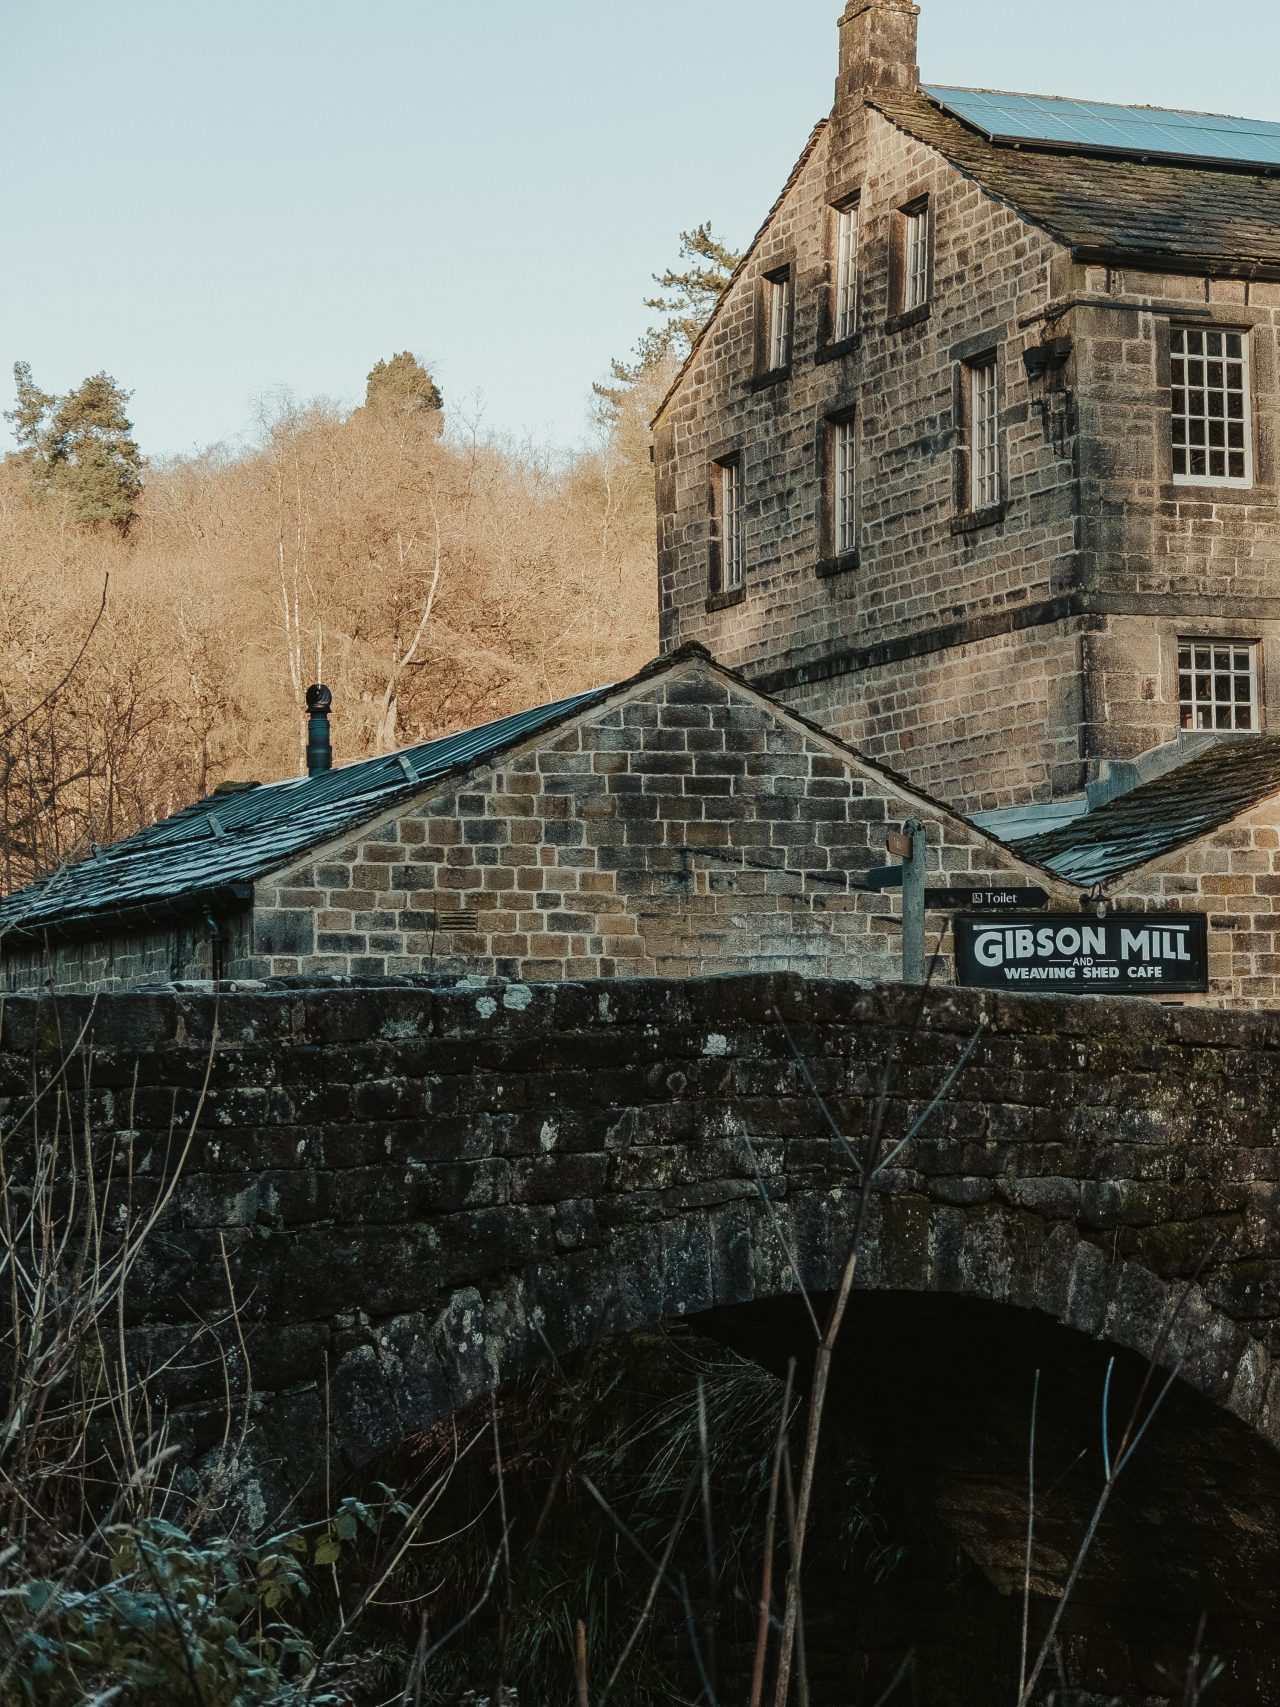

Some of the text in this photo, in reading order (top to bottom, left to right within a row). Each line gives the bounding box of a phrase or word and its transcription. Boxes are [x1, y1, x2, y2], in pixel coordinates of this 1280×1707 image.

[985, 892, 1018, 904] Toilet
[973, 926, 1191, 967] GIBSON MILL
[1072, 957, 1094, 967] AND
[1003, 966, 1163, 980] WEAVING SHED CAFE
